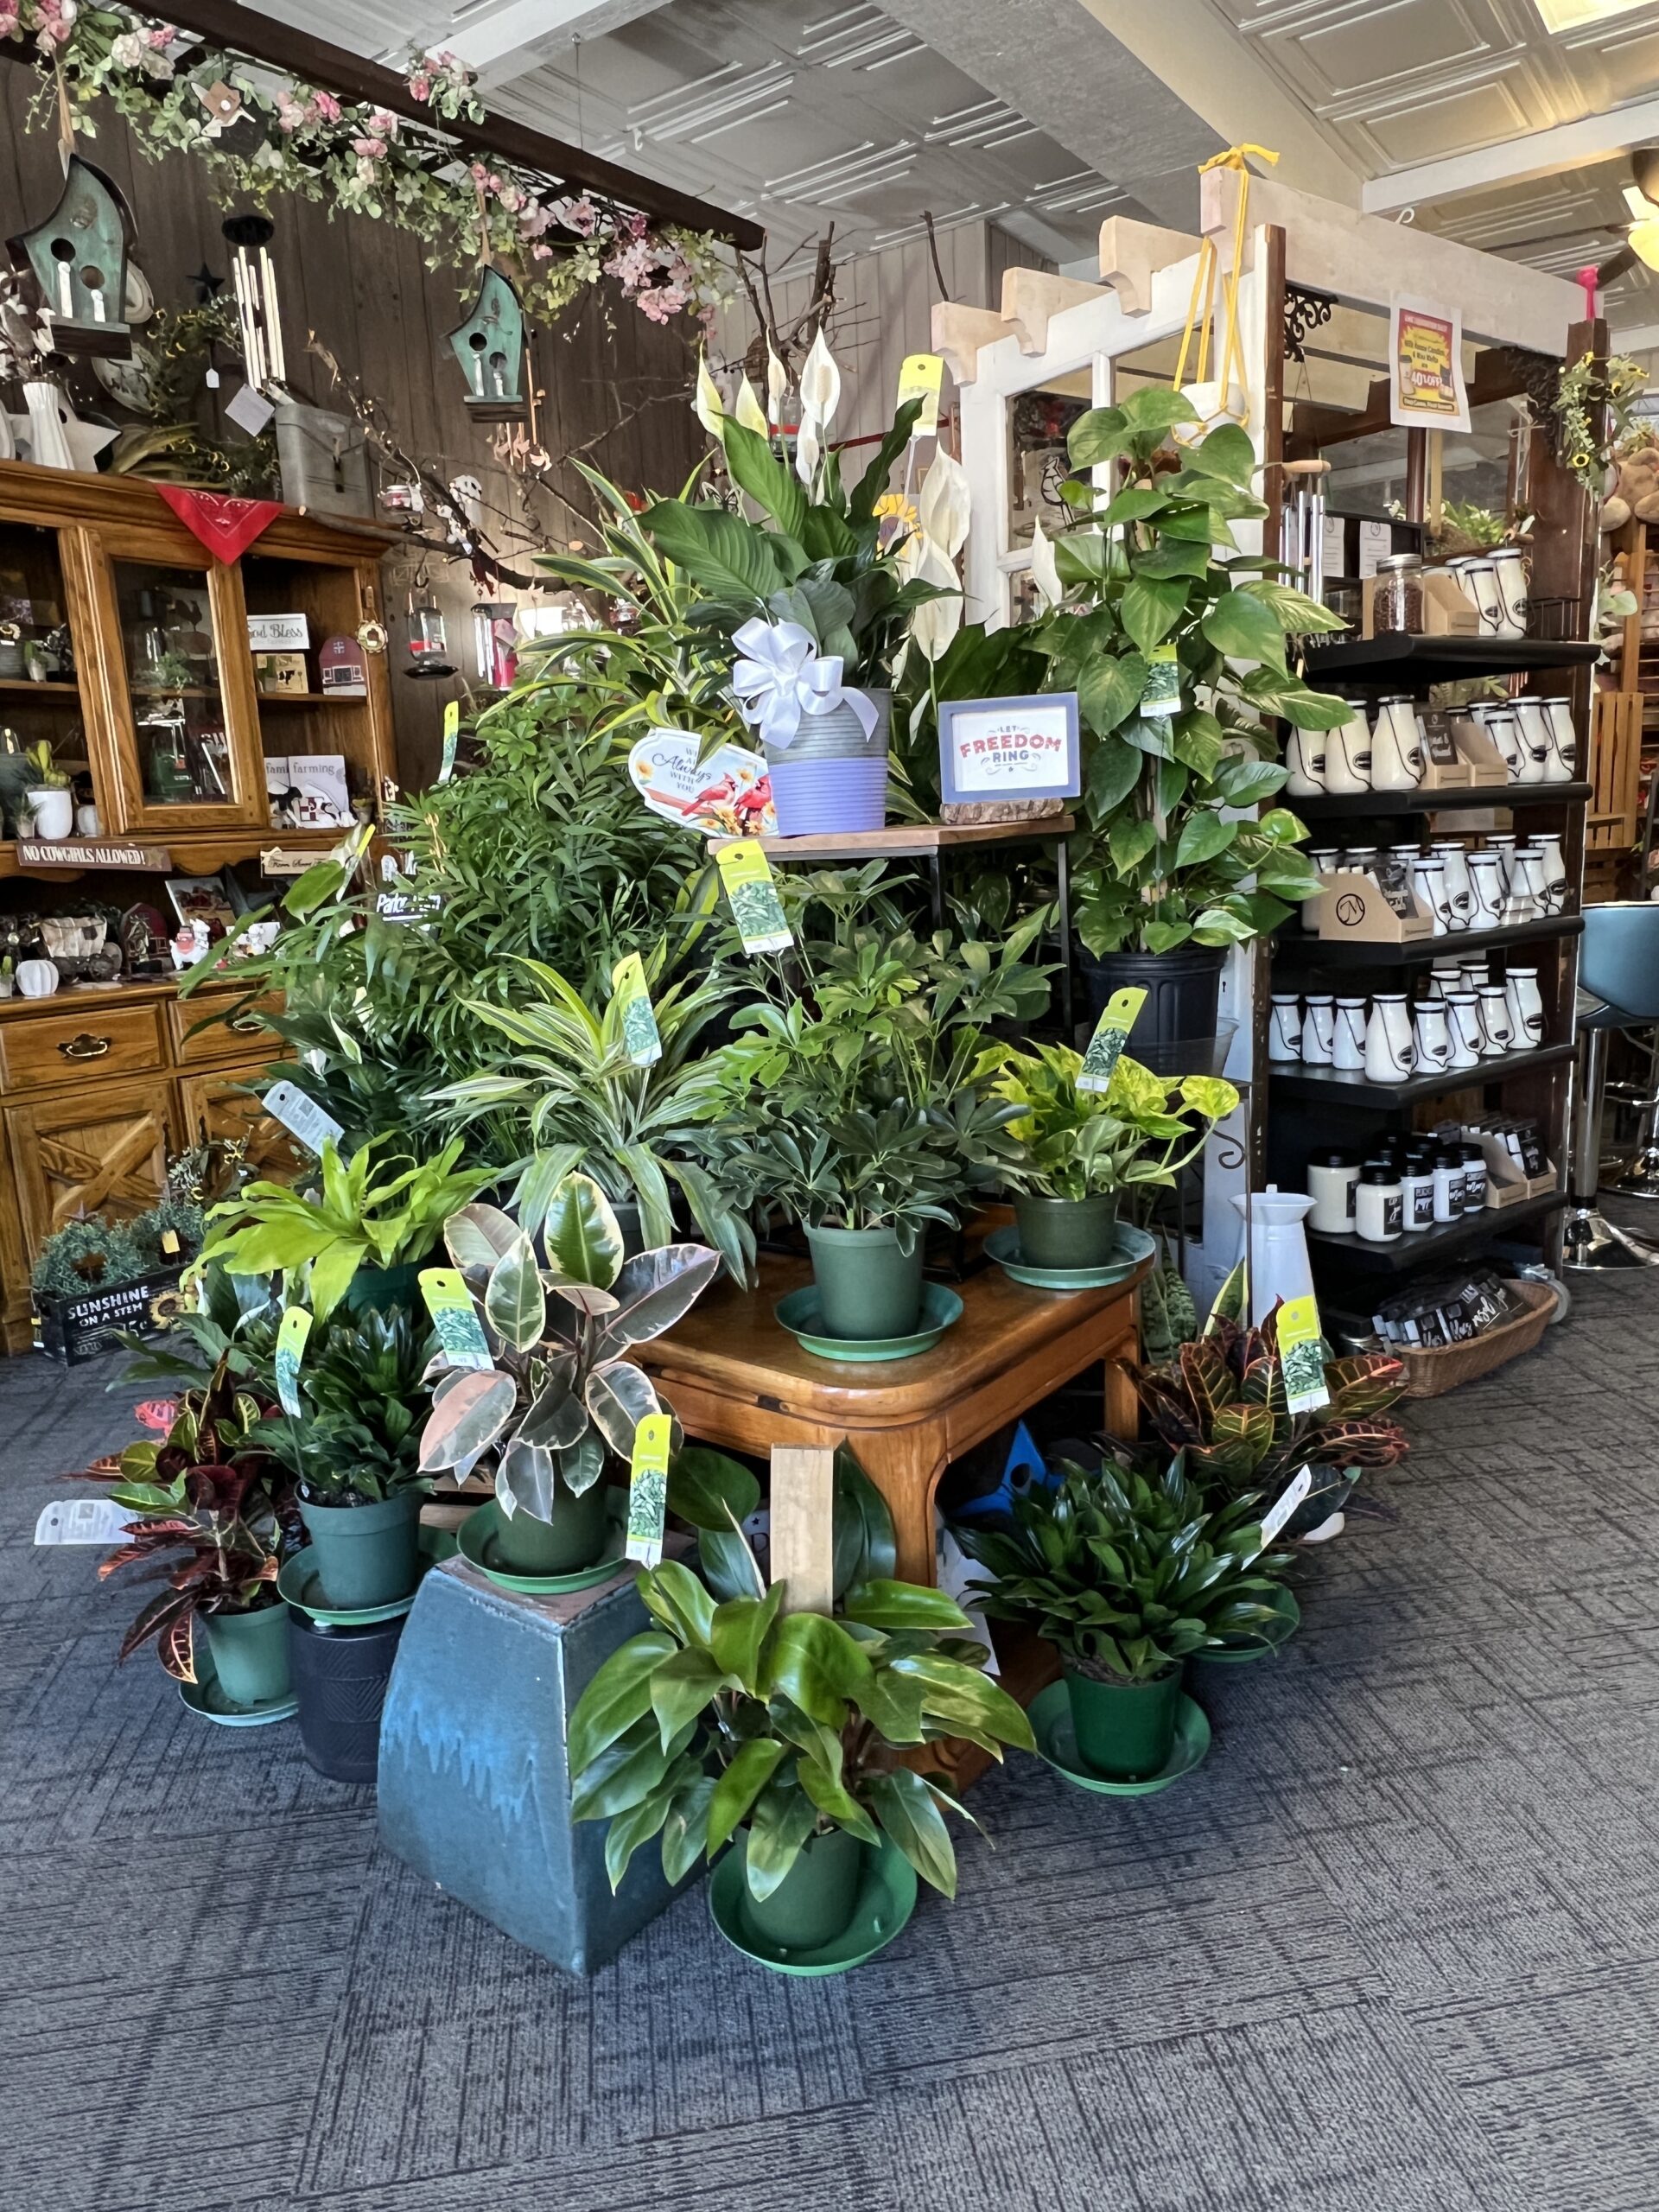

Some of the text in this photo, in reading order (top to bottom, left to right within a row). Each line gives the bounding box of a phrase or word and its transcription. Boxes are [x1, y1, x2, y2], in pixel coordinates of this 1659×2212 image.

[270, 623, 303, 639] Bless
[959, 734, 1062, 758] FREEDOM
[993, 750, 1029, 763] RING
[294, 762, 335, 776] farming
[652, 753, 712, 784] Always
[671, 771, 695, 785] WITH
[677, 782, 695, 793] YOU
[22, 845, 40, 861] NO
[41, 846, 95, 863] COWGIRLS
[67, 1286, 149, 1319] SUNSHINE
[79, 1302, 143, 1327] ON A STEM
